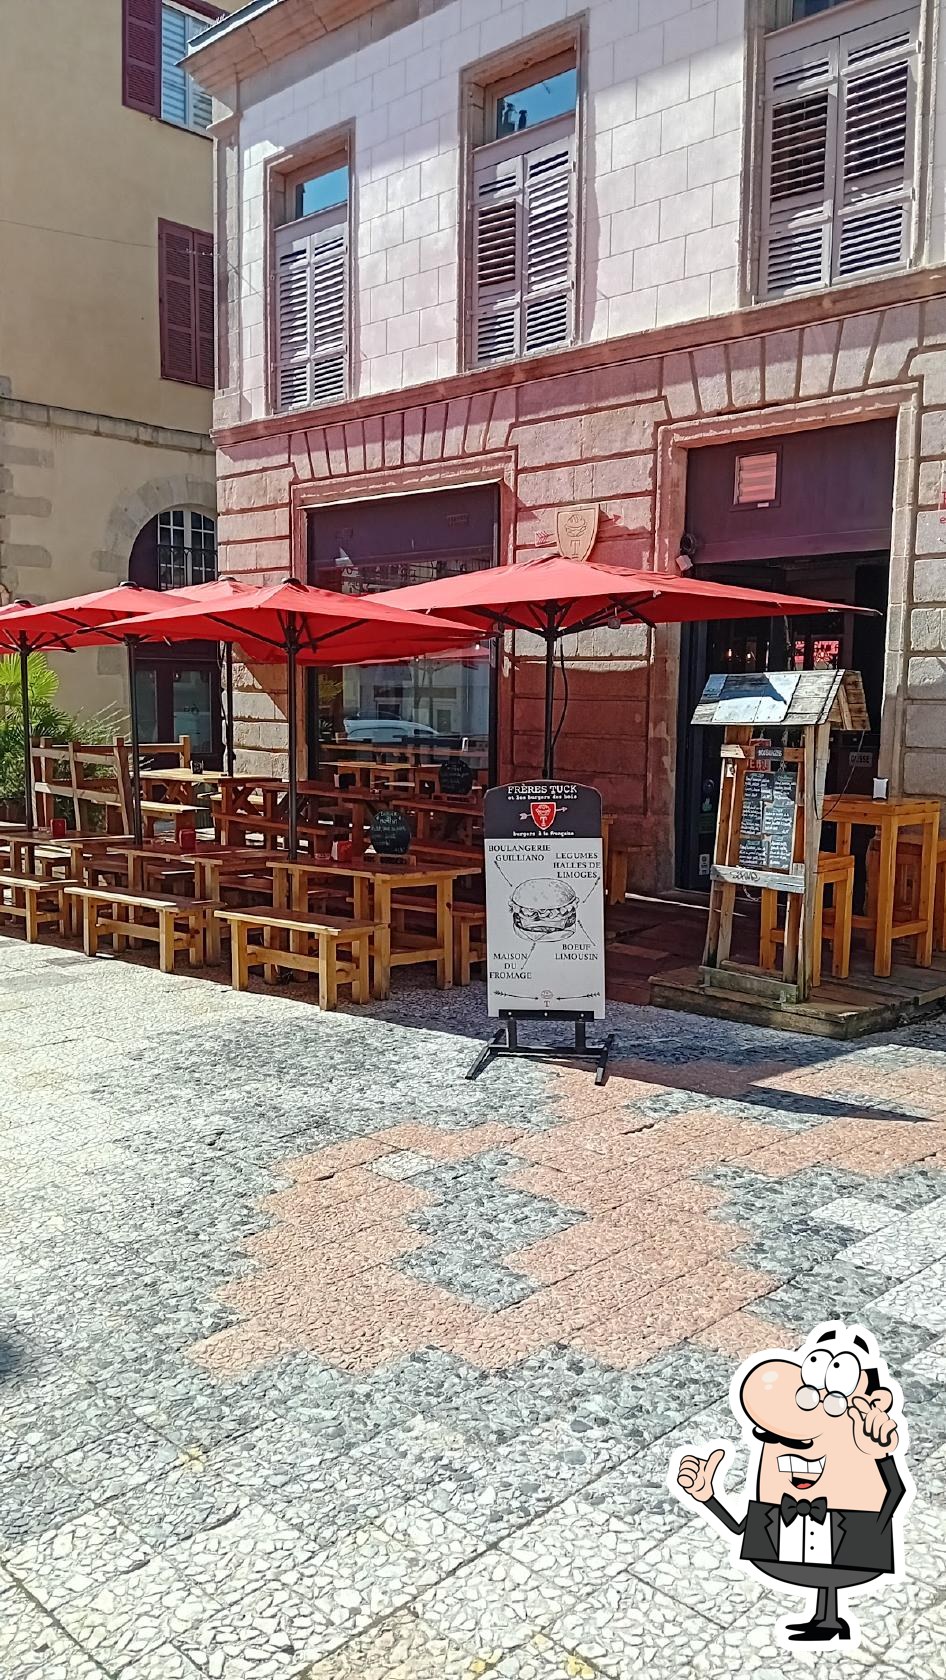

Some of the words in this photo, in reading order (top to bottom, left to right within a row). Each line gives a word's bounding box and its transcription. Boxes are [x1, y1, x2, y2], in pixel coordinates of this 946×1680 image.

[508, 784, 548, 794] FRÈRES
[550, 785, 577, 794] TUCK
[540, 816, 547, 826] T
[488, 844, 551, 852] BOULANGERIE
[495, 854, 545, 862] GUILLIANO
[555, 852, 598, 860] LEGUMES
[553, 861, 587, 869] HALLES
[588, 861, 601, 869] DE
[557, 871, 598, 879] LIMOGES
[562, 943, 592, 951] BOEUF
[554, 952, 599, 961] LIMOUSIN
[504, 962, 517, 970] DU
[489, 971, 532, 979] FROMAGE
